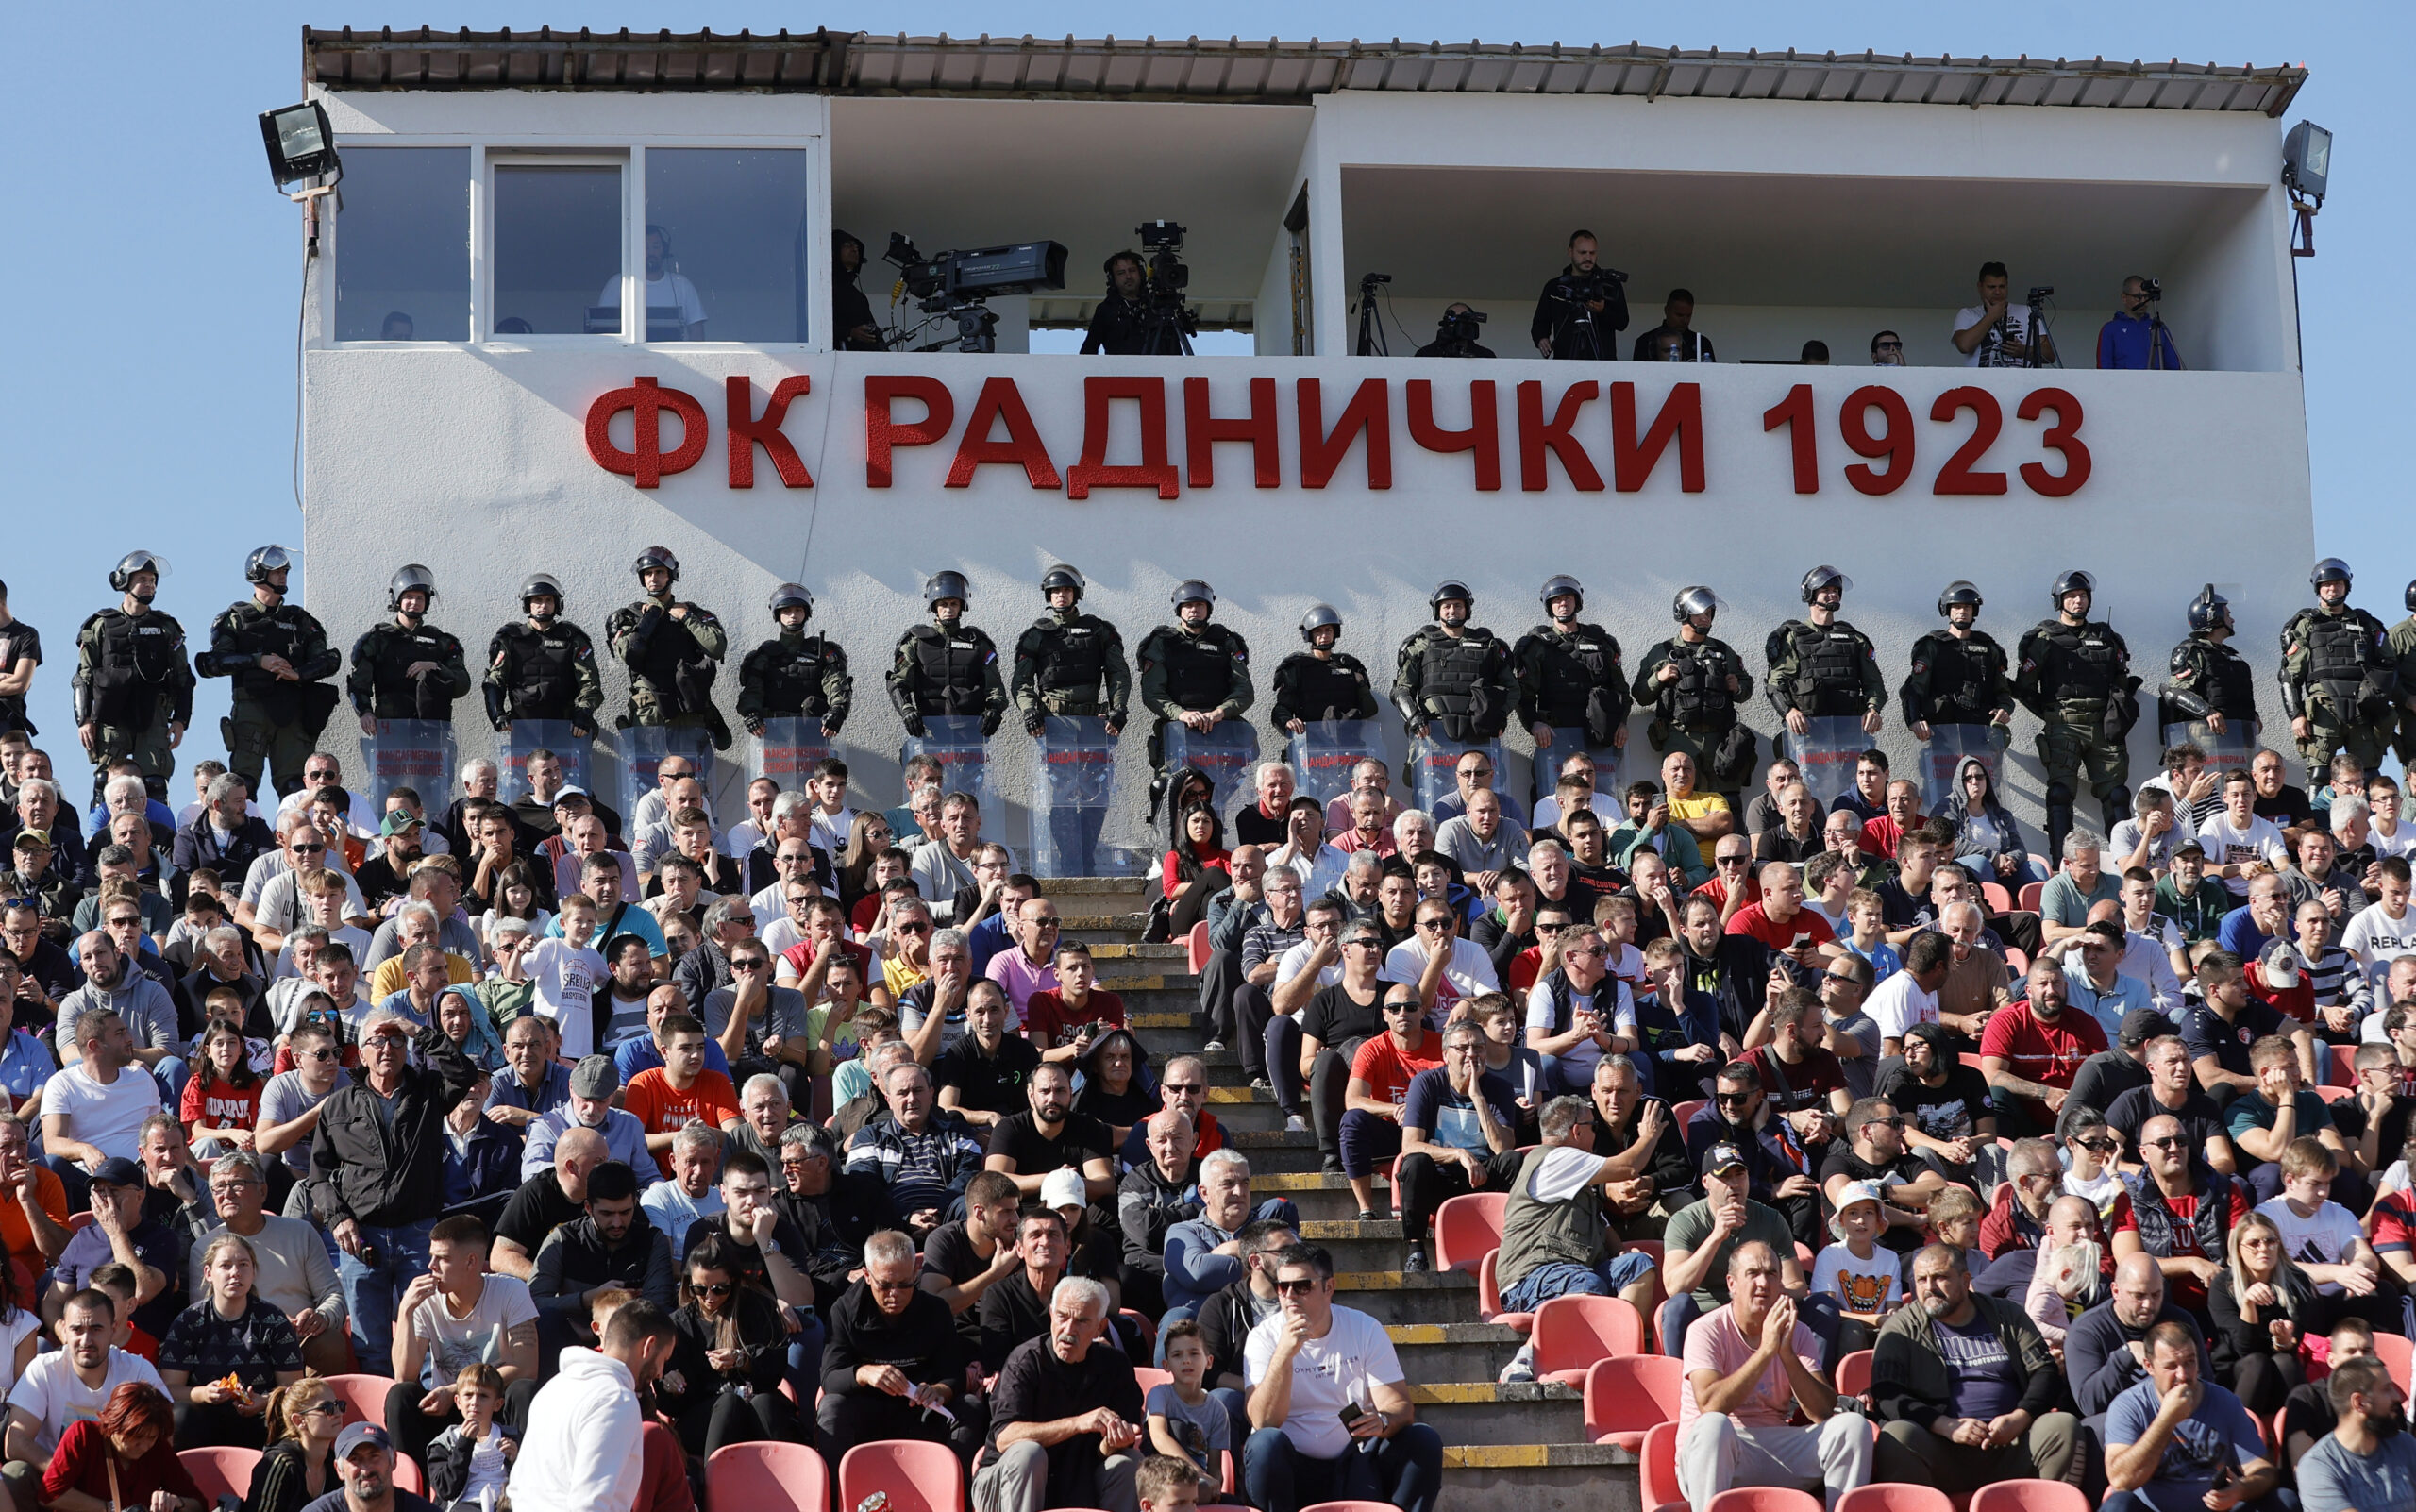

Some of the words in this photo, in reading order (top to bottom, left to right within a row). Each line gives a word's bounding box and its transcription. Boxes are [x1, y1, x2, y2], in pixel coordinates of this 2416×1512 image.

[584, 375, 814, 489] ФК
[864, 375, 1705, 500] РАДНИЧКИ
[1763, 383, 2092, 497] 1923
[377, 748, 443, 763] ЖАНДАРМЕРИЈА
[377, 764, 443, 777] GENDARMERIE
